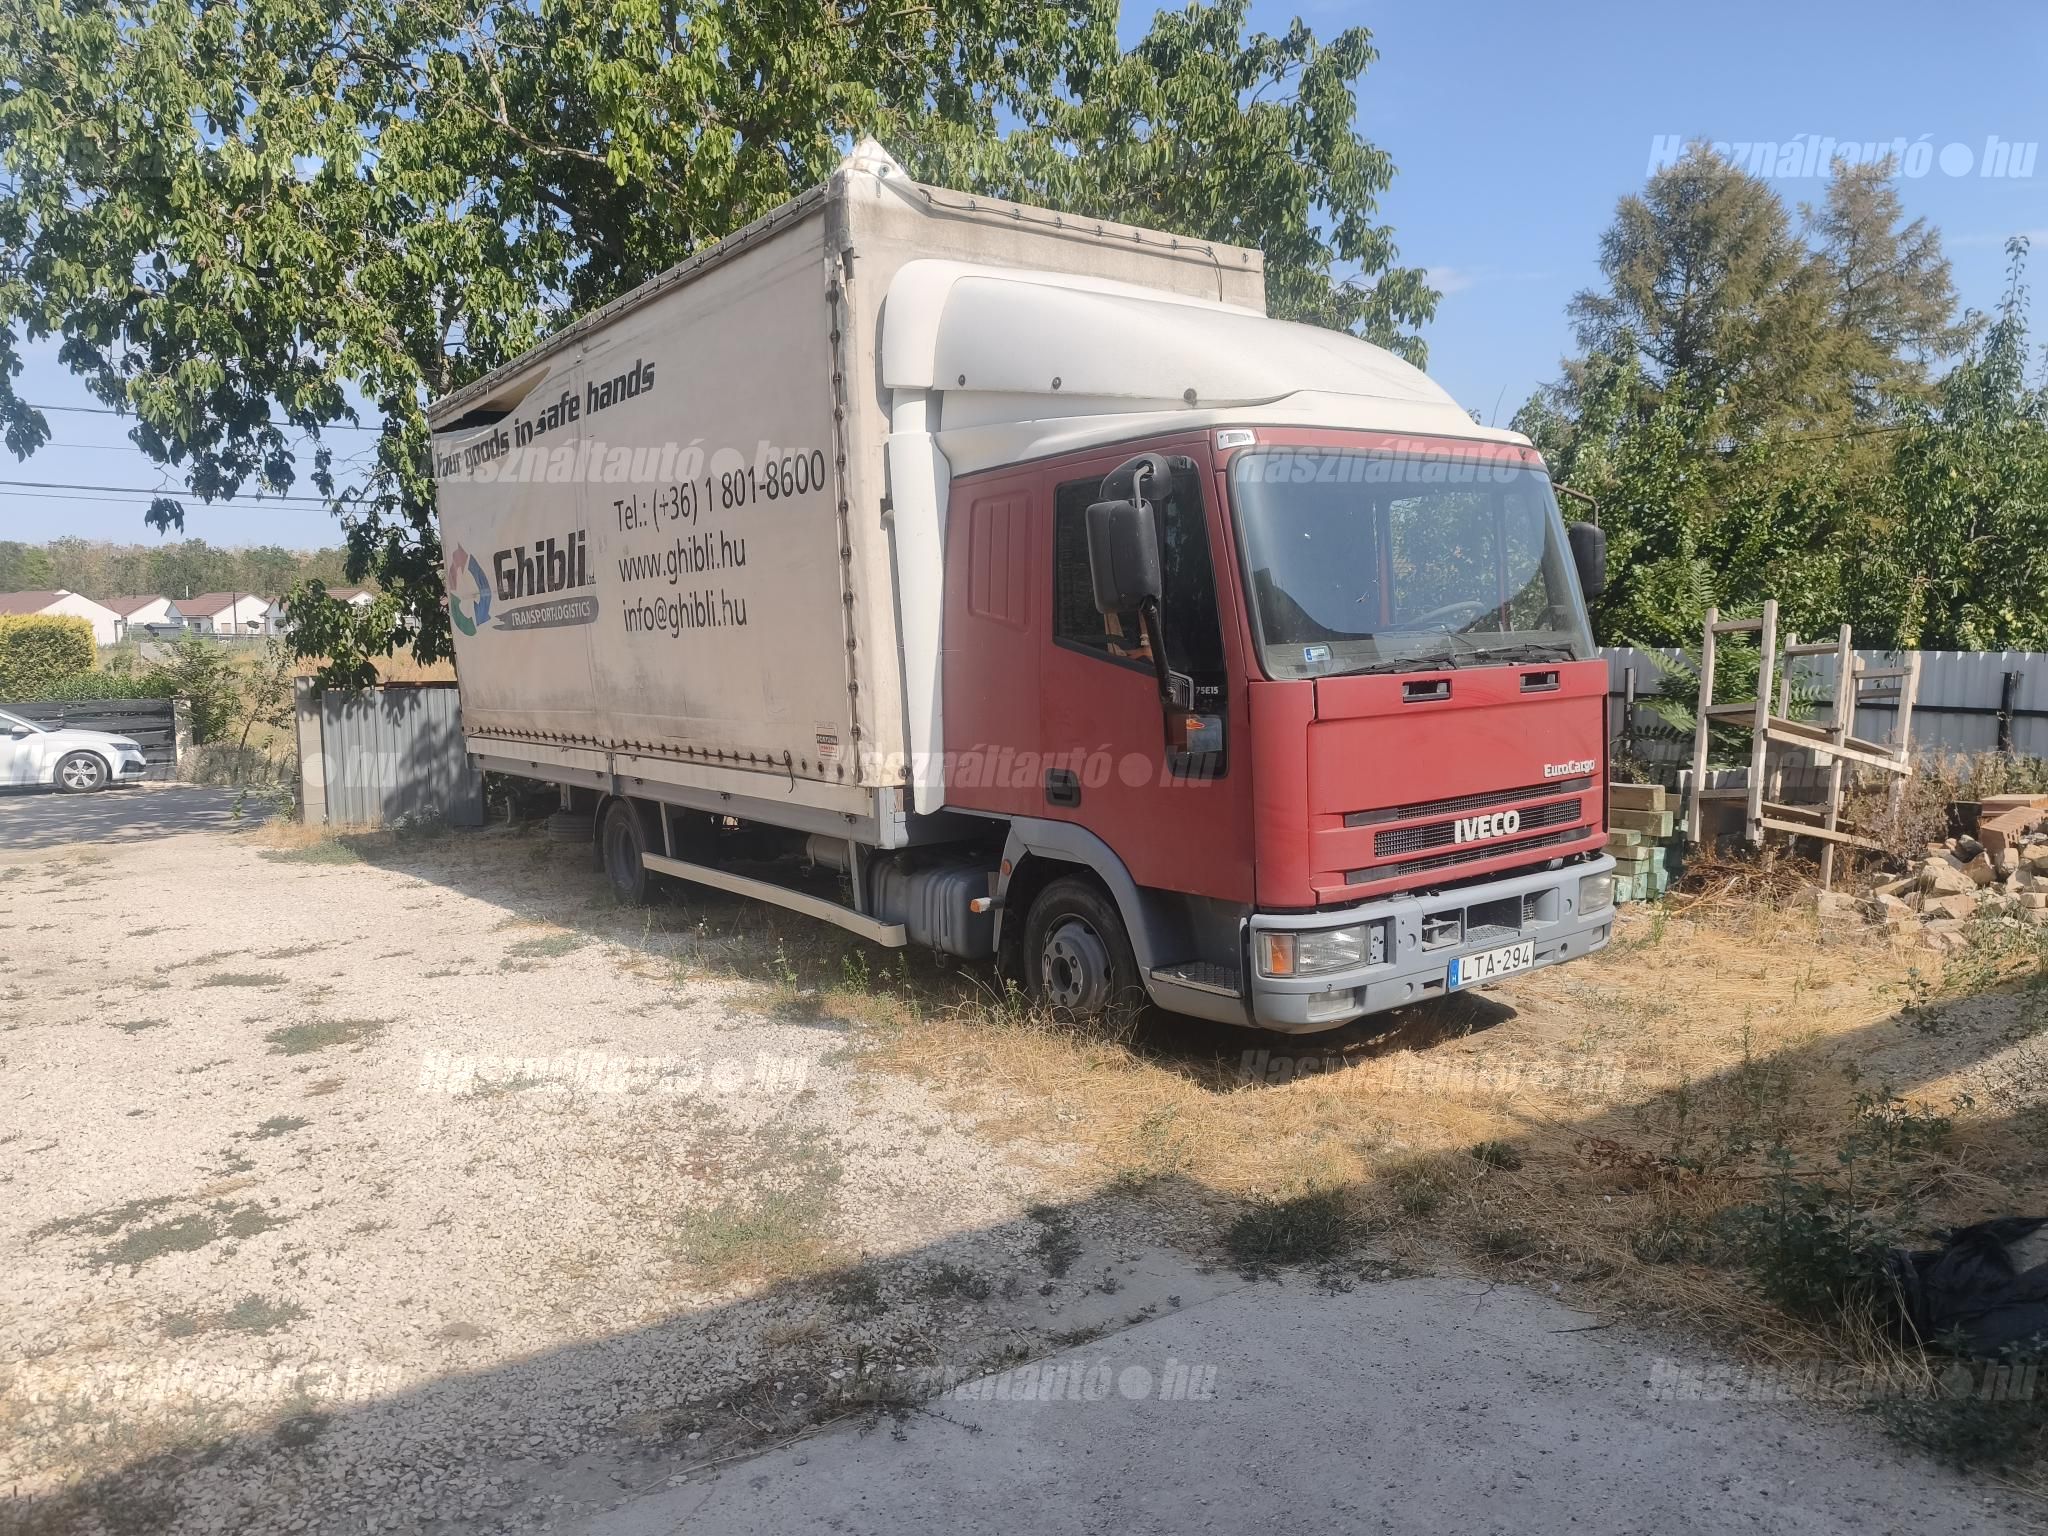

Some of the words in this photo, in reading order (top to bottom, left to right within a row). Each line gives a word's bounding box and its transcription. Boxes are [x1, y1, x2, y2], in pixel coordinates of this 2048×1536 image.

[465, 428, 510, 474] goods
[515, 418, 534, 448] in
[534, 390, 581, 436] safe
[587, 358, 655, 415] hands
[614, 494, 648, 532] Tel.:
[653, 480, 698, 532] (+36)
[705, 477, 713, 512] 1
[721, 450, 825, 508] 801-8600
[493, 529, 586, 601] Ghibli
[619, 530, 746, 584] www.ghibli.hu
[623, 588, 747, 638] info@ghibli.hu
[1195, 686, 1219, 695] 75E15
[1544, 759, 1596, 778] EuroCargo
[1454, 810, 1520, 844] IVECO
[1462, 945, 1530, 981] LTA-294
